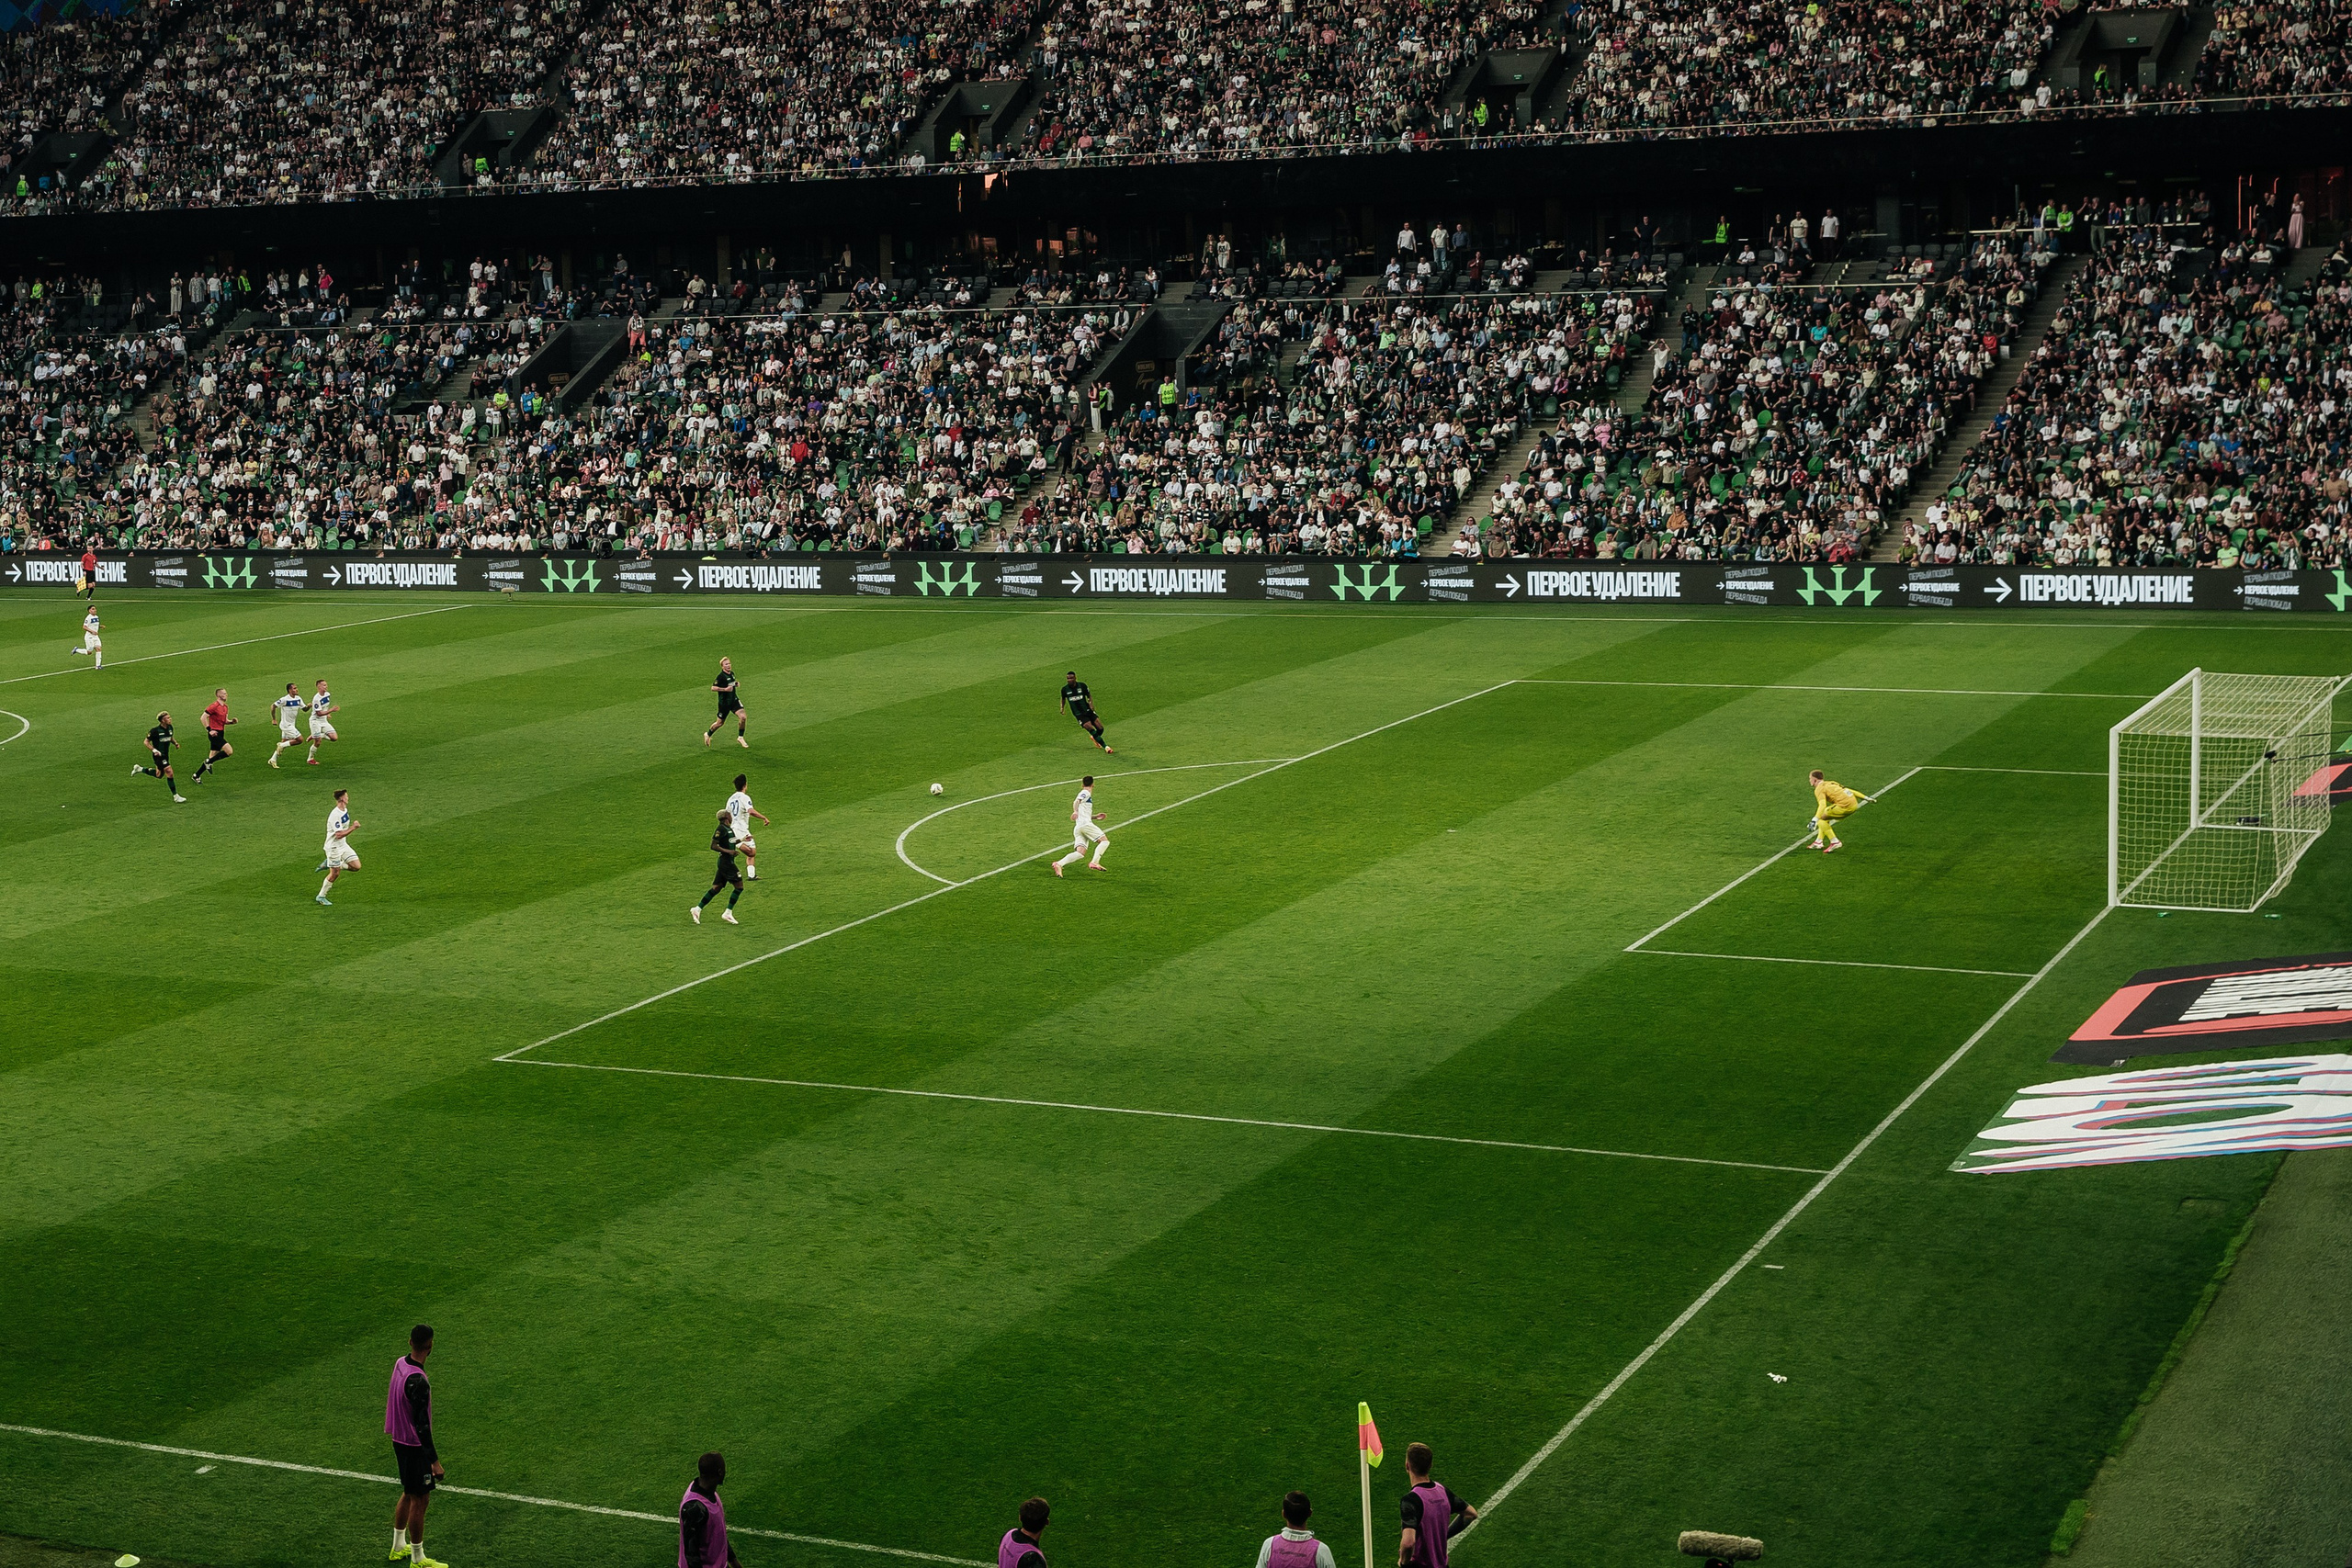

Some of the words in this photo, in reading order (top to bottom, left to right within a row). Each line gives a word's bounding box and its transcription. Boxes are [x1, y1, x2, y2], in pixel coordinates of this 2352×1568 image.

[26, 561, 68, 581] ПЕРВОЕ
[68, 561, 127, 584] УДЕНИЕ
[345, 563, 393, 584] ПЕРВОЕ
[393, 563, 457, 587] УДАЛЕНИЕ
[698, 566, 750, 588] ПЕРВОЕ
[750, 566, 821, 591] УДАЛЕНИЕ
[1090, 569, 1148, 592] ПЕРВОЕ
[1148, 569, 1227, 595] УДАЛЕНИЕ
[1527, 571, 1592, 596] ПЕРВОЕ
[1592, 572, 1681, 600] УДАЛЕНИЕ
[2019, 574, 2092, 601] ПЕРВОЕ
[2092, 575, 2194, 605] УДАЛЕНИЕ
